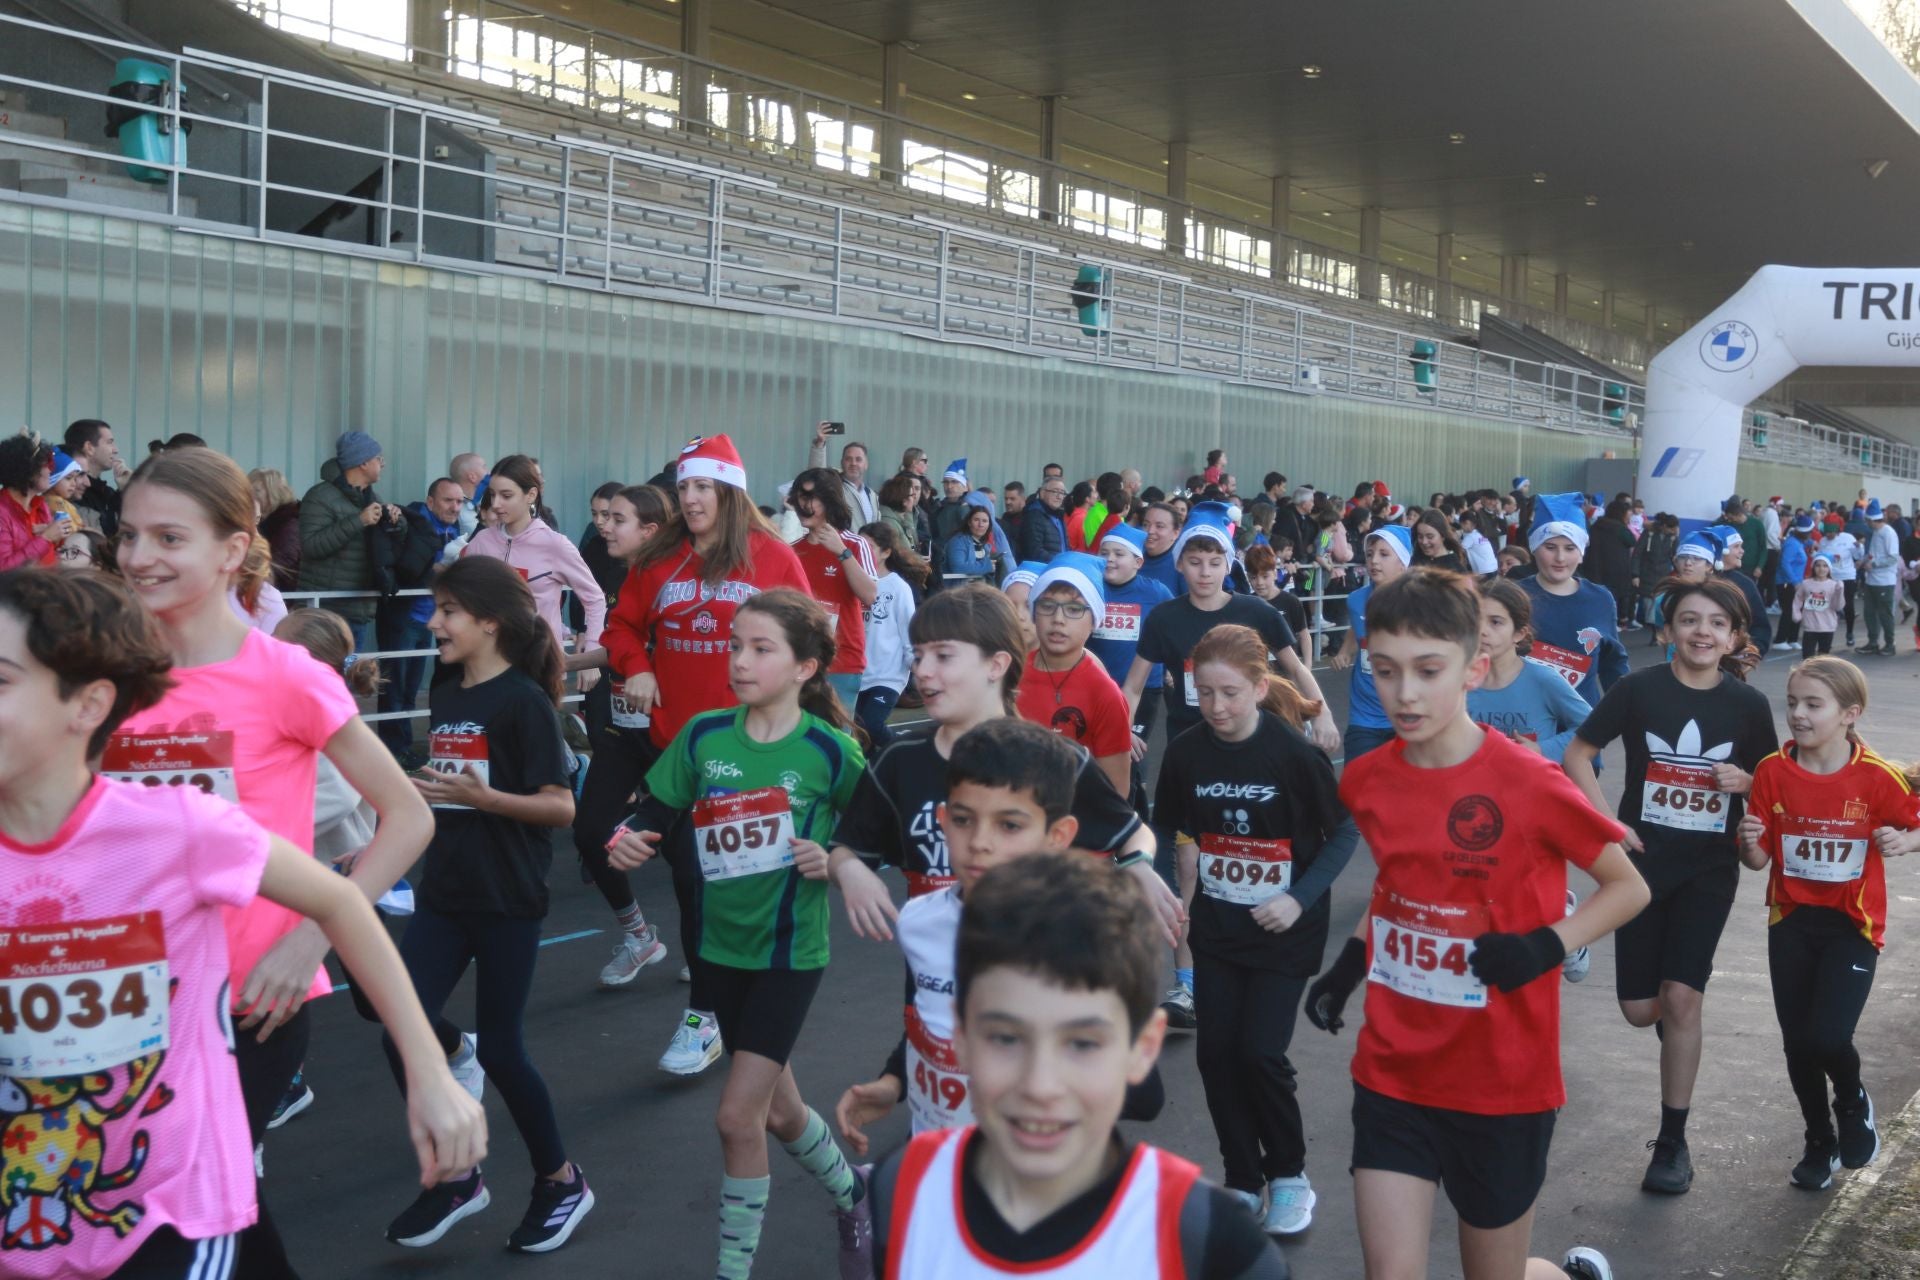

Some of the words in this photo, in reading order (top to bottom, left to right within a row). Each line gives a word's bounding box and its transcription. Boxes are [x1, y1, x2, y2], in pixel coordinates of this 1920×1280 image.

[1823, 281, 1920, 321] TRI
[1467, 711, 1529, 728] AISON
[169, 734, 209, 746] Popular
[154, 747, 168, 757] de
[742, 791, 770, 801] Popular
[1651, 786, 1723, 814] 4056
[1808, 817, 1831, 825] Carrera
[1831, 819, 1856, 827] Popular
[705, 816, 781, 856] 4057
[1795, 838, 1853, 863] 4117
[1208, 858, 1282, 886] 4094
[1430, 904, 1468, 916] Popular
[18, 930, 70, 945] Carrera
[71, 924, 128, 941] Popular
[49, 945, 68, 957] de
[1383, 927, 1469, 977] 4154
[11, 957, 107, 977] Nochebuena
[914, 1059, 972, 1111] 419
